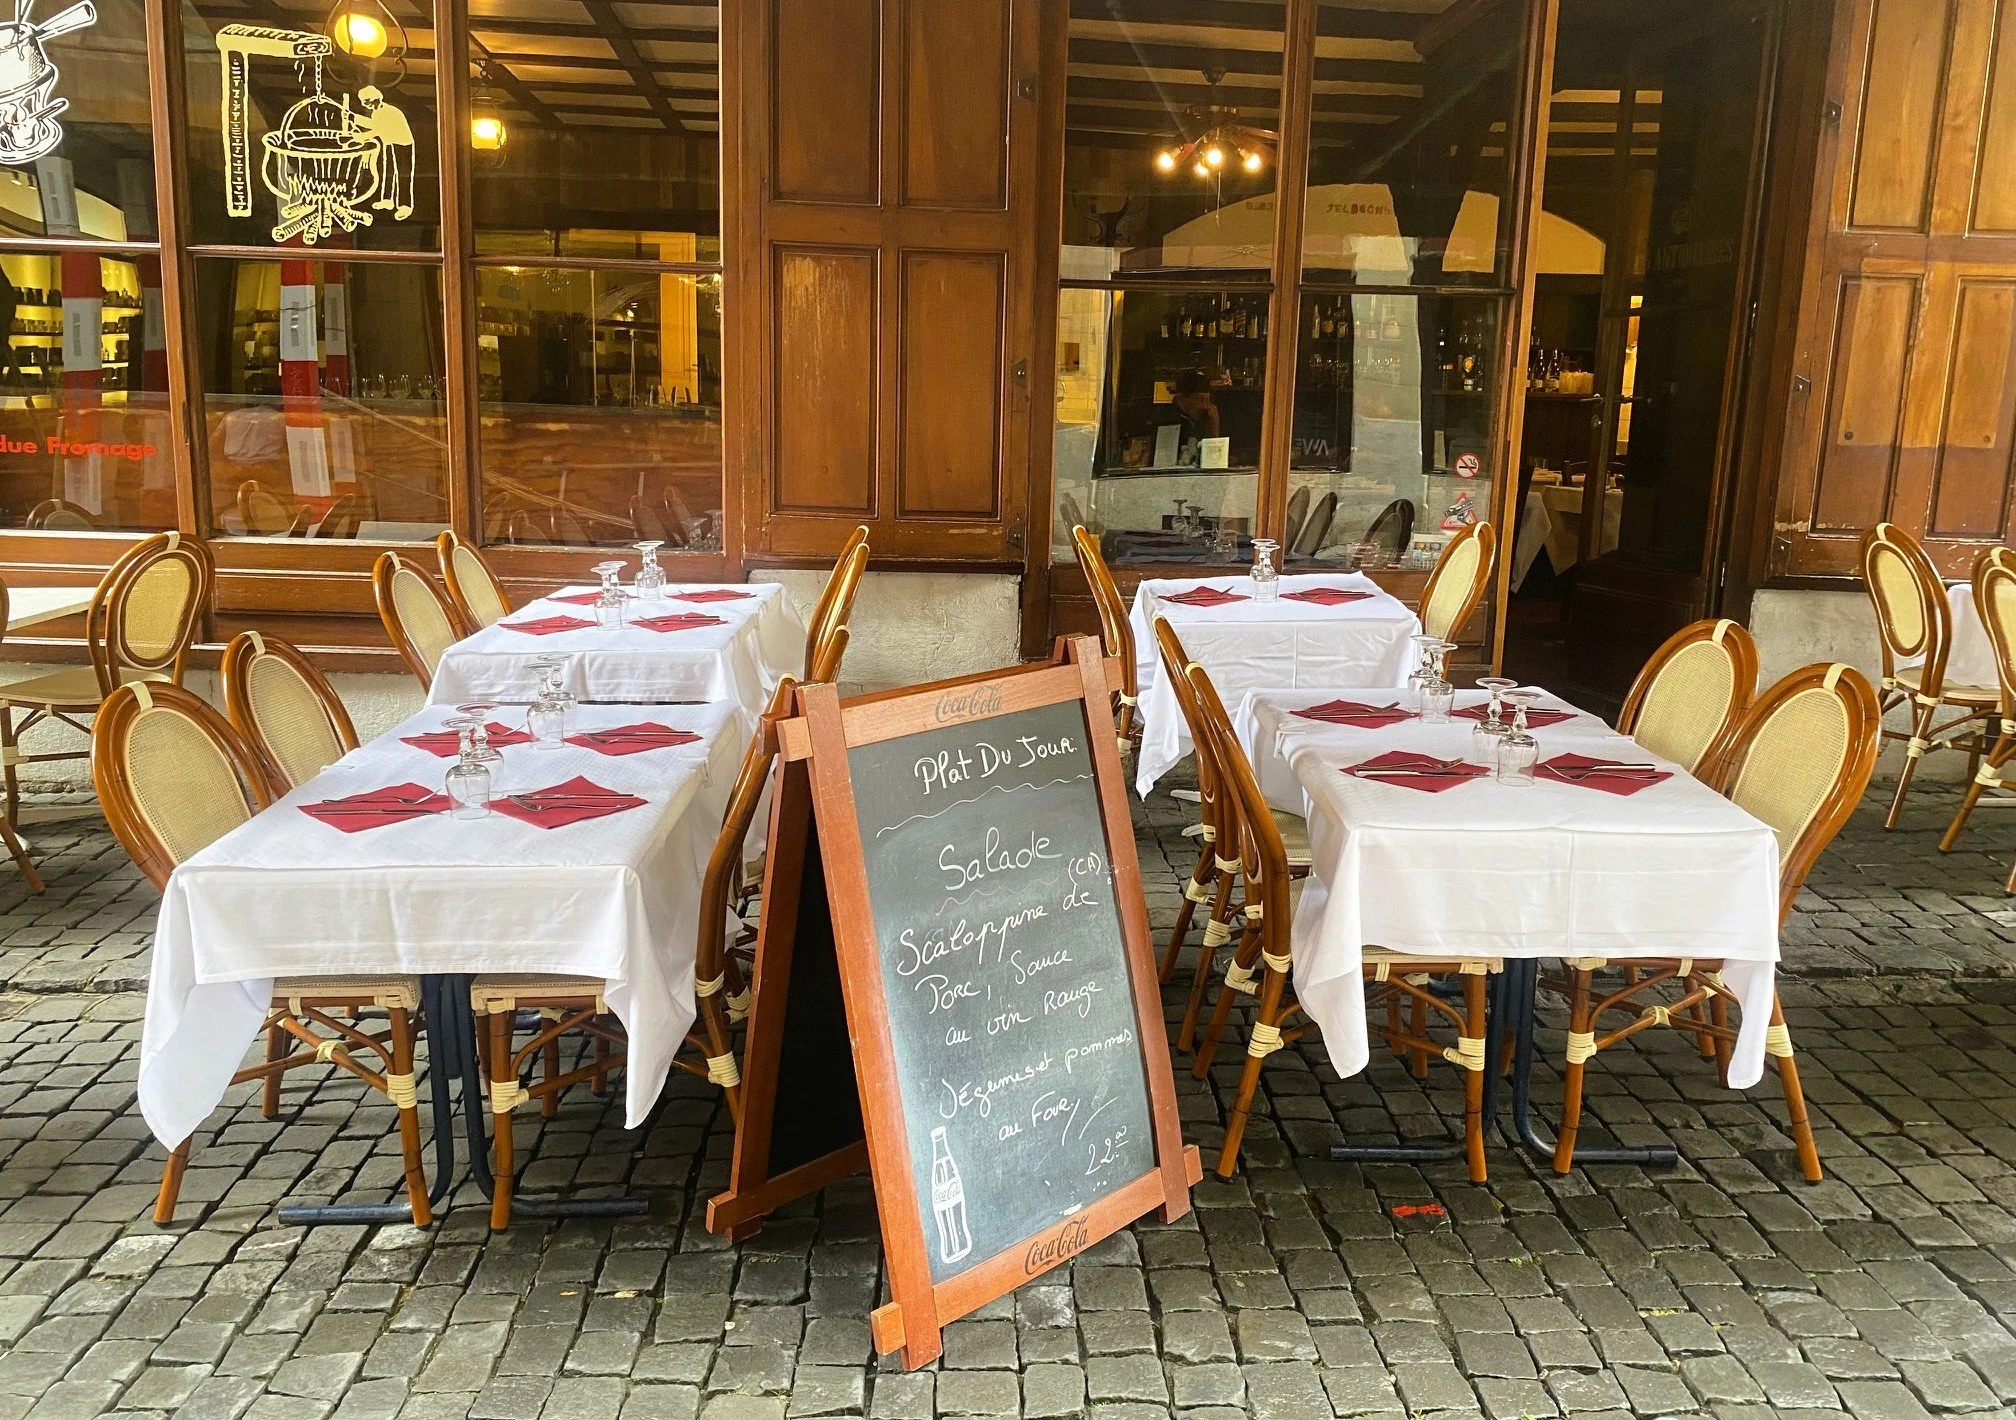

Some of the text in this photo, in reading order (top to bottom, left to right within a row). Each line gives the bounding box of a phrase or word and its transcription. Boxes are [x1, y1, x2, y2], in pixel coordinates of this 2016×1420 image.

[46, 436, 157, 461] Fromage
[935, 682, 1003, 723] Coca-Cola
[914, 749, 972, 795] Plat
[975, 742, 1011, 778] Du
[938, 826, 1062, 891] Salade
[896, 883, 1099, 976] Scaloppine de
[1009, 949, 1073, 985] Sauce
[945, 1026, 972, 1046] au
[986, 1003, 1032, 1035] vin
[1065, 1028, 1132, 1075] pommes
[998, 1122, 1023, 1141] au
[1025, 1214, 1089, 1276] Coca-Cola
